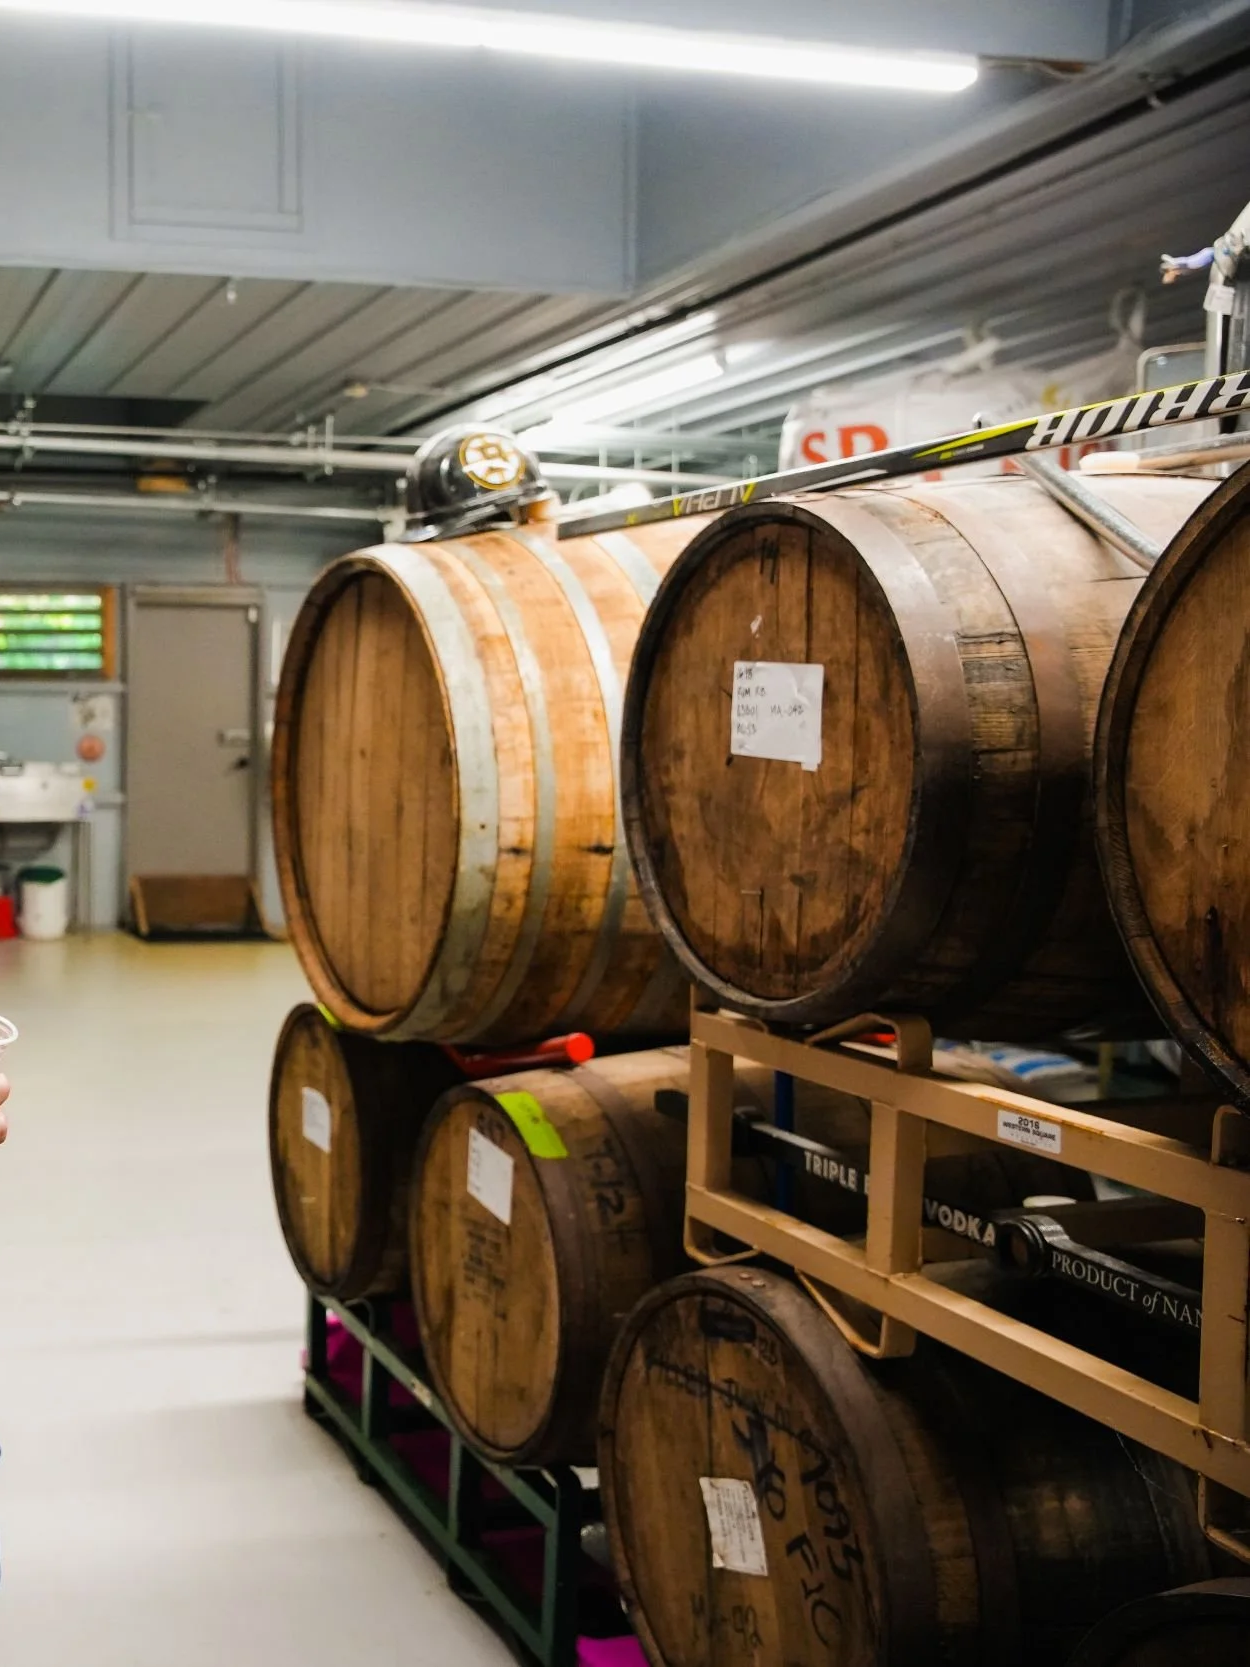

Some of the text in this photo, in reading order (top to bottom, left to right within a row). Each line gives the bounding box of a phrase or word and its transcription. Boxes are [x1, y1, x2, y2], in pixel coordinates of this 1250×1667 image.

[672, 482, 757, 517] ALPHA
[804, 1151, 858, 1193] TRIPLE
[924, 1198, 997, 1248] VODKA
[1052, 1251, 1140, 1302] PRODUCT
[1142, 1291, 1161, 1315] of
